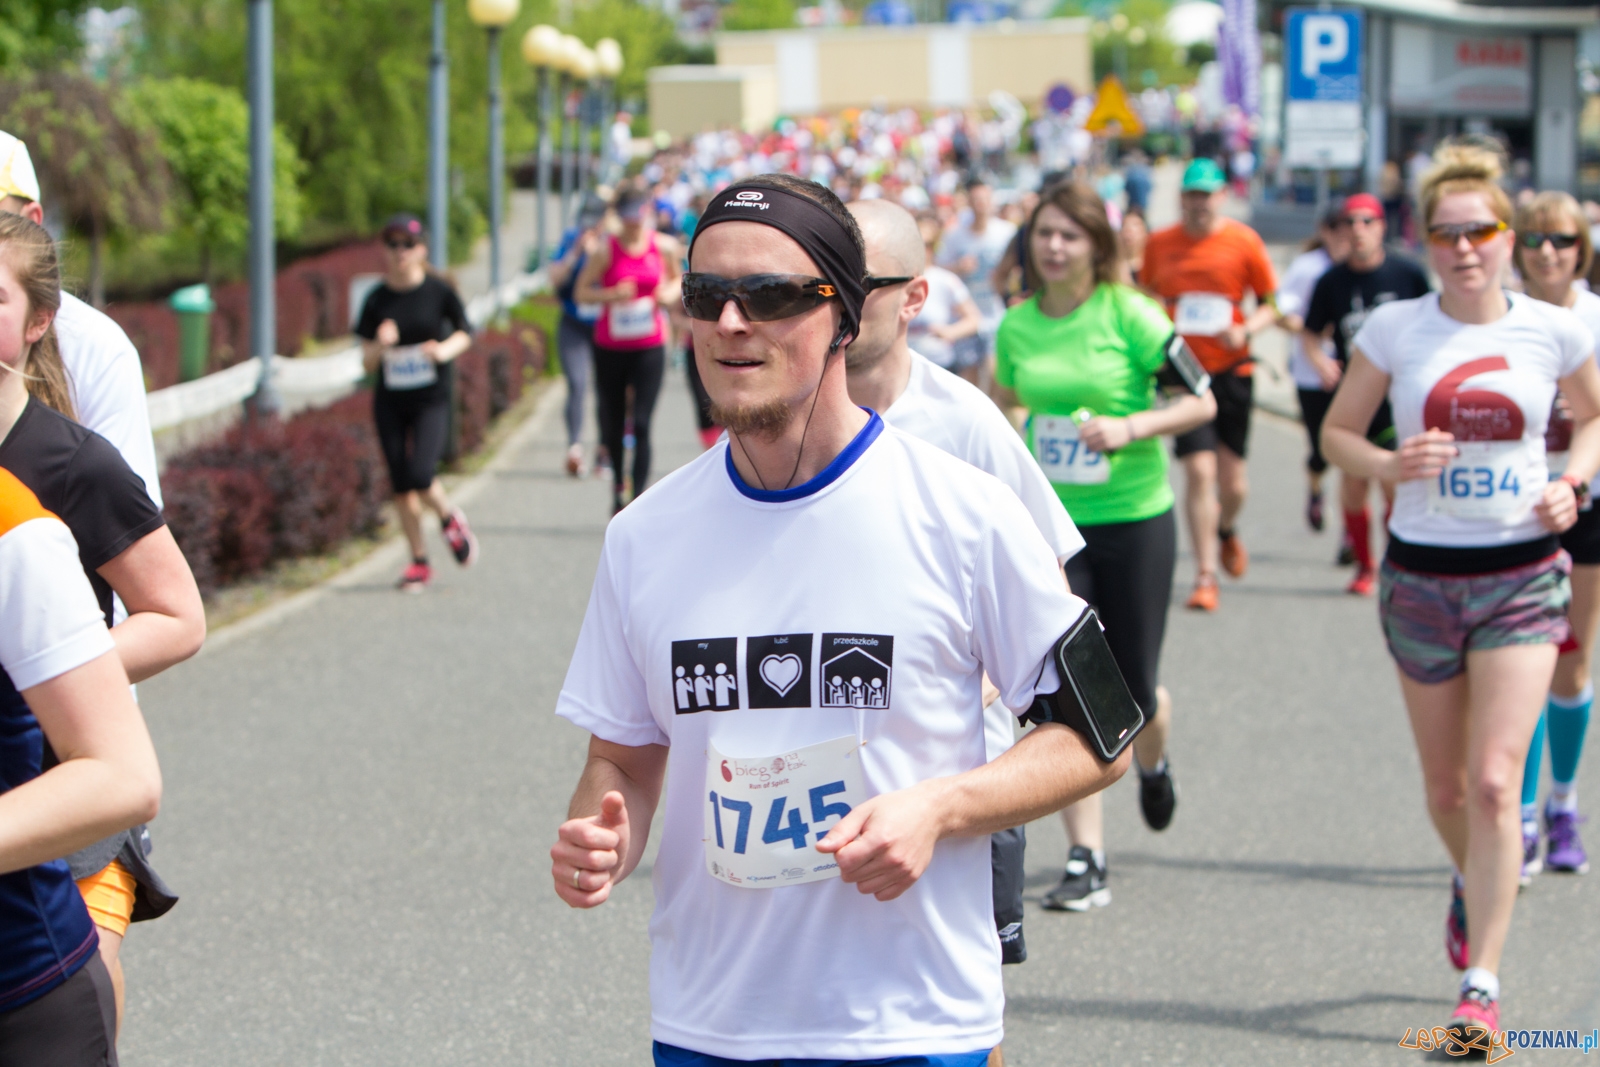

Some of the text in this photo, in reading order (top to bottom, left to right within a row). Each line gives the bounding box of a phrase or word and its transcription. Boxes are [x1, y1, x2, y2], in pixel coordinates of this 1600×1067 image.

[1301, 16, 1349, 78] P
[724, 200, 770, 210] Kalenji
[1439, 467, 1520, 497] 1634
[697, 642, 710, 651] my
[832, 637, 879, 646] przedszkole
[734, 760, 771, 782] bieg
[771, 778, 790, 788] Spirit
[709, 780, 853, 855] 1745
